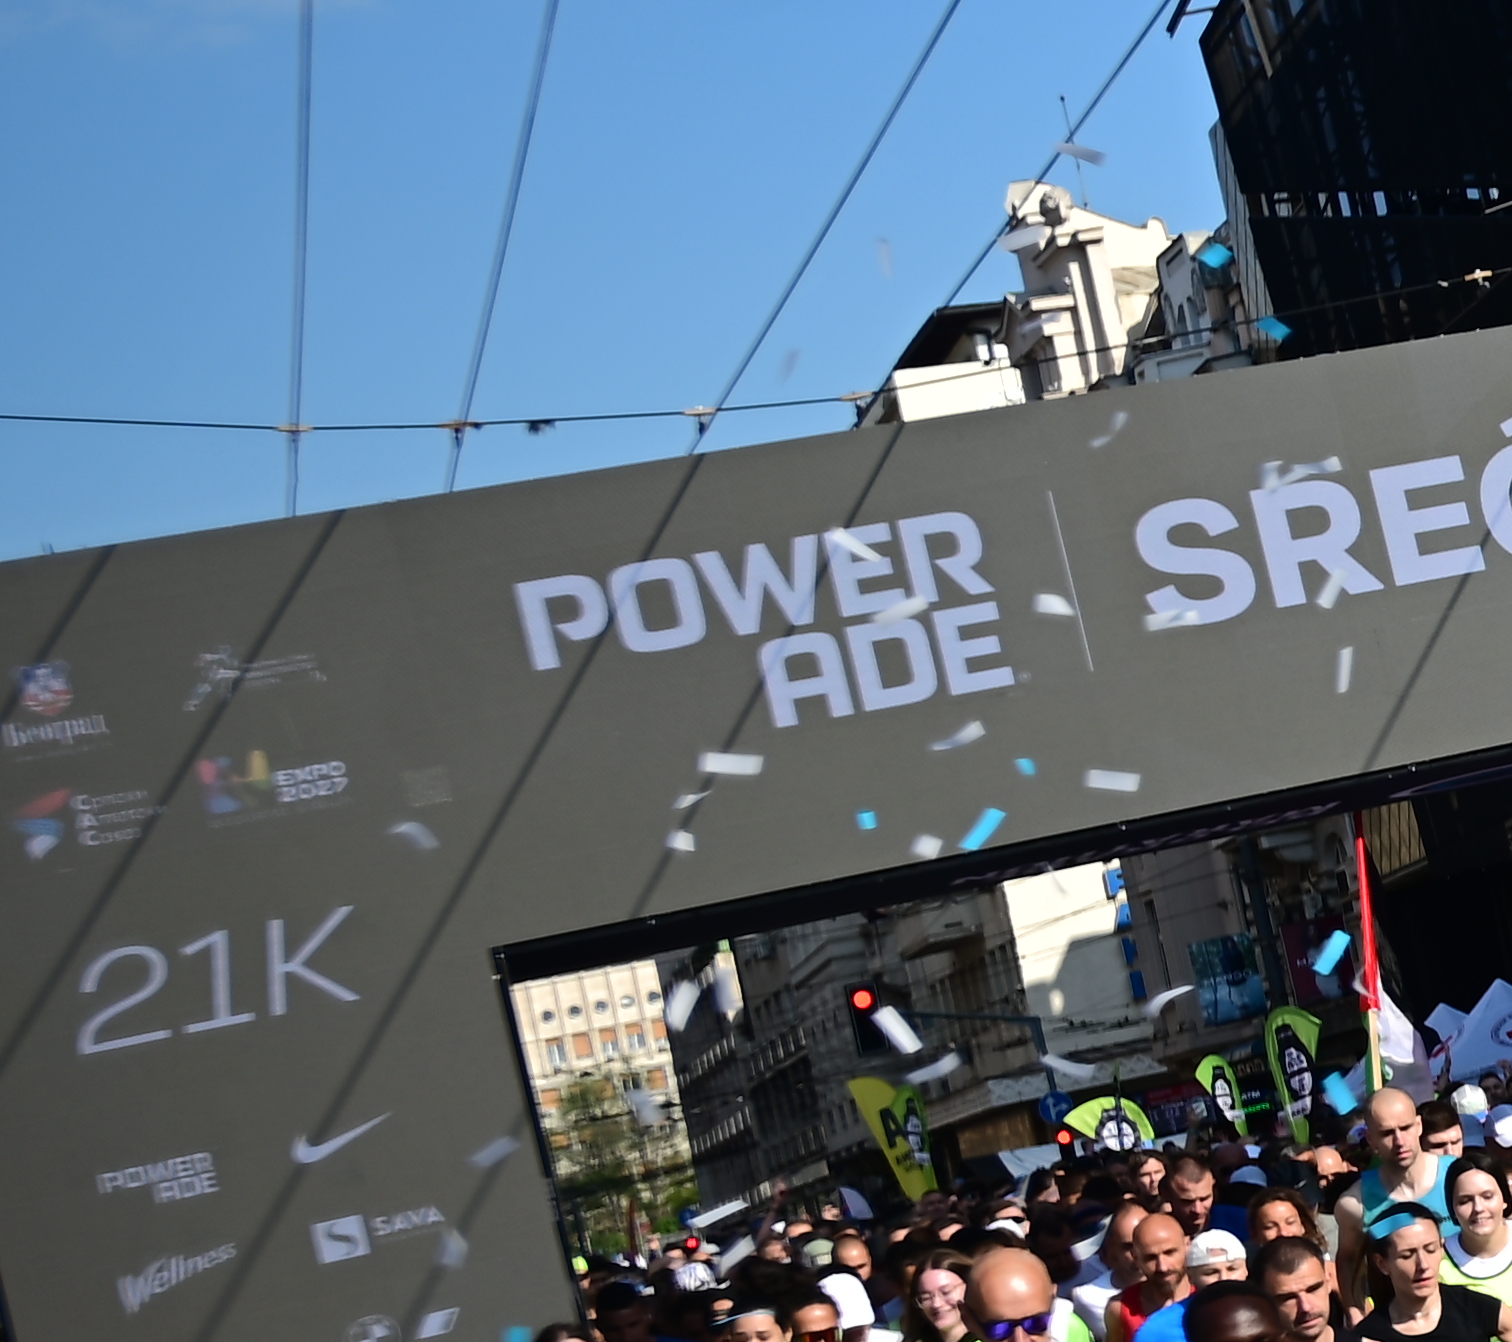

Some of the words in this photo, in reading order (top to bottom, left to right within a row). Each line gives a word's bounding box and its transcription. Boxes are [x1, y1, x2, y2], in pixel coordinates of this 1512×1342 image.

[513, 511, 996, 671] POWER
[757, 600, 1016, 728] ADE
[275, 760, 346, 786] EXPO
[276, 777, 349, 803] 2027
[76, 904, 362, 1056] 21K
[96, 1152, 215, 1194] POWER
[152, 1172, 221, 1204] ADE
[369, 1204, 446, 1237] SAVA
[117, 1241, 238, 1316] Wellness
